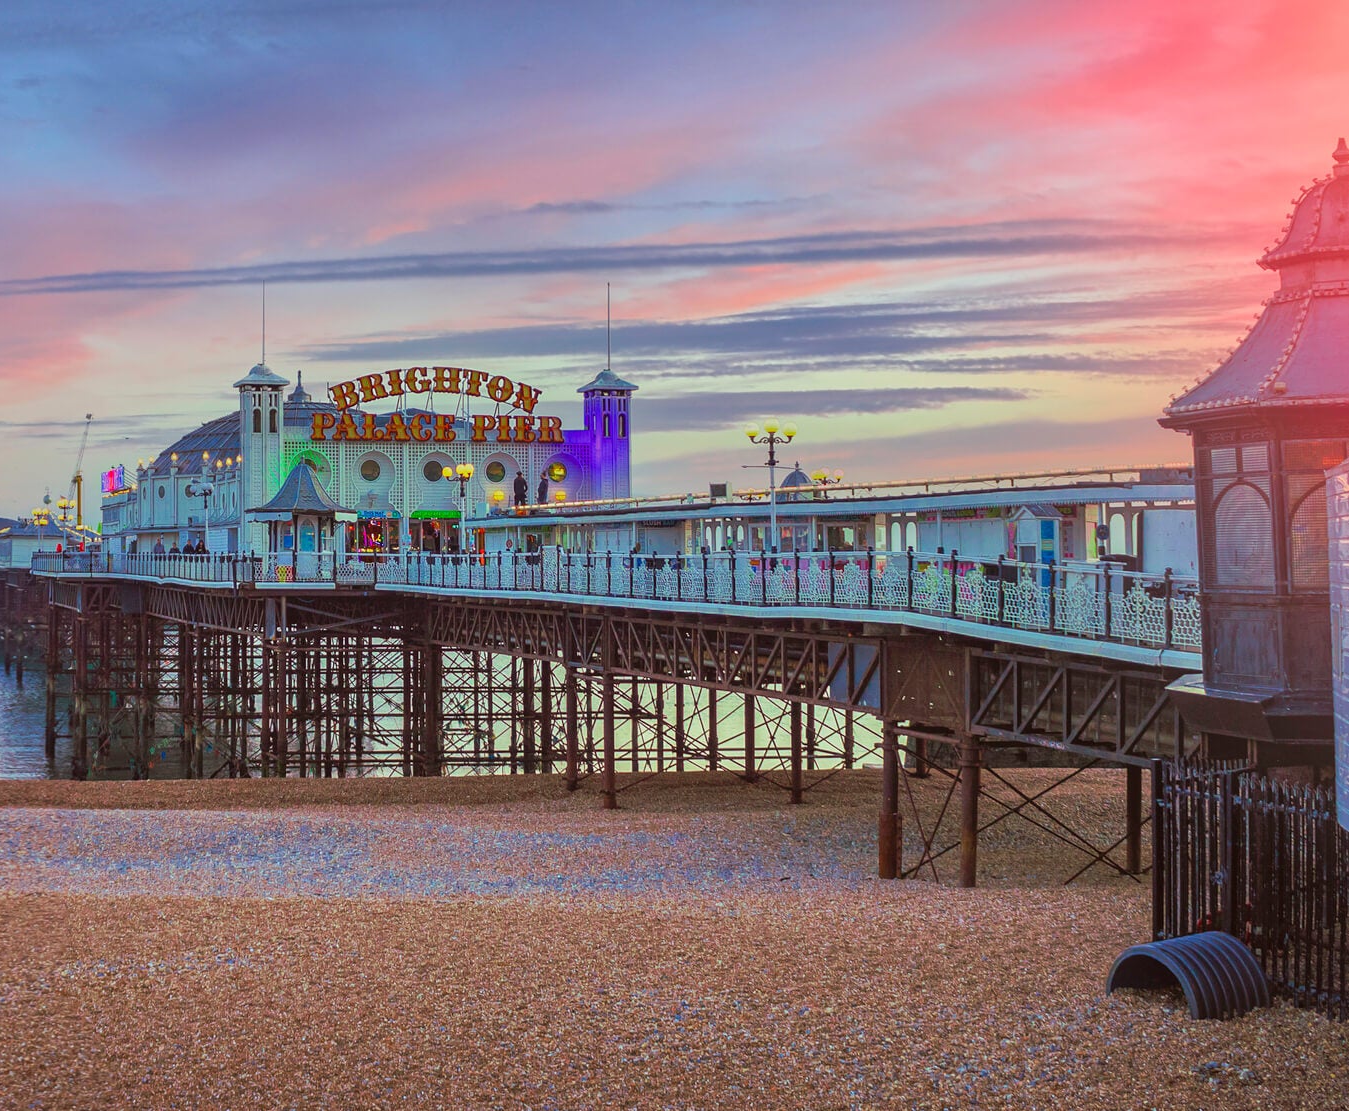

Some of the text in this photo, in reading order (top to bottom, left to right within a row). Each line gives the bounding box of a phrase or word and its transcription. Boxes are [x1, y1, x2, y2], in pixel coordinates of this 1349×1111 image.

[329, 366, 542, 414] BRIGHTON
[311, 412, 565, 443] PALACE PIER
